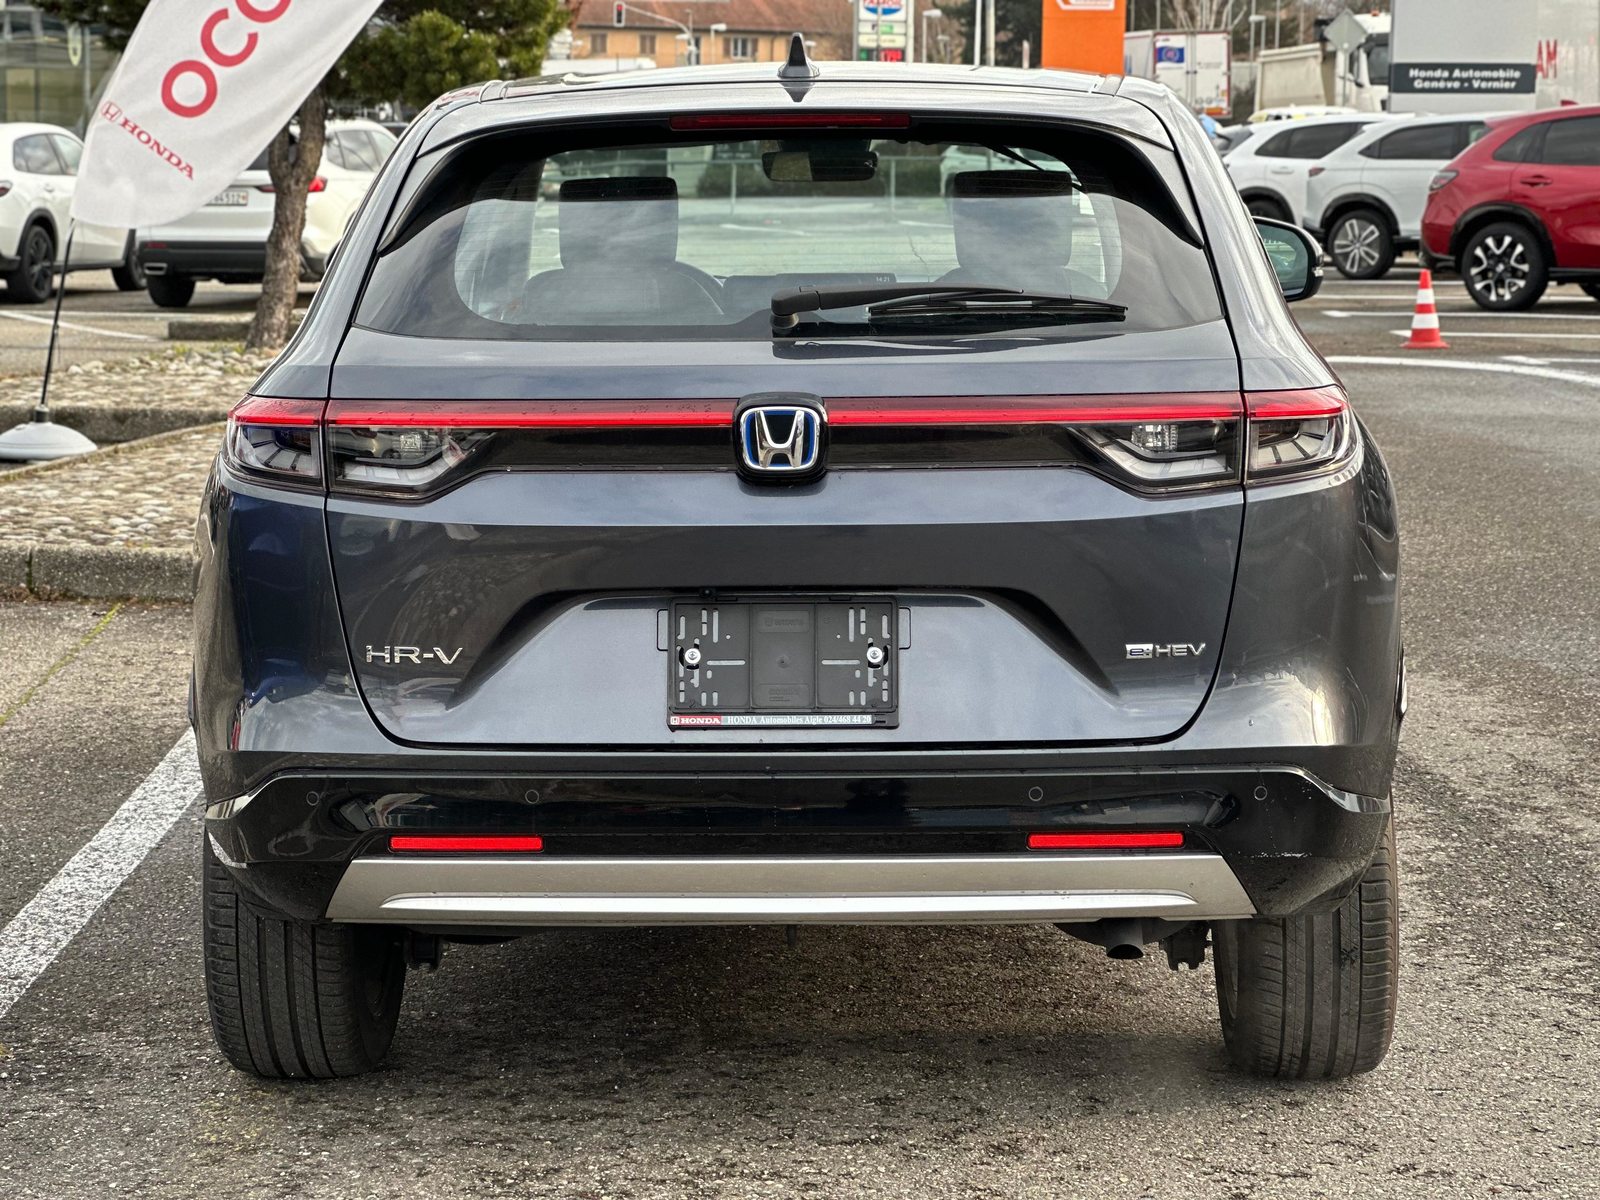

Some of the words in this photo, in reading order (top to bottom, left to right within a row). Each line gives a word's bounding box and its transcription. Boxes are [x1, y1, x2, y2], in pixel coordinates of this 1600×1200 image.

[1409, 68, 1449, 78] Honda
[1452, 68, 1521, 78] Automobile
[1472, 79, 1517, 89] Vernier
[120, 117, 194, 181] HONDA
[365, 645, 463, 665] HR-V
[680, 716, 721, 725] HONDA
[727, 715, 757, 725] HONDA
